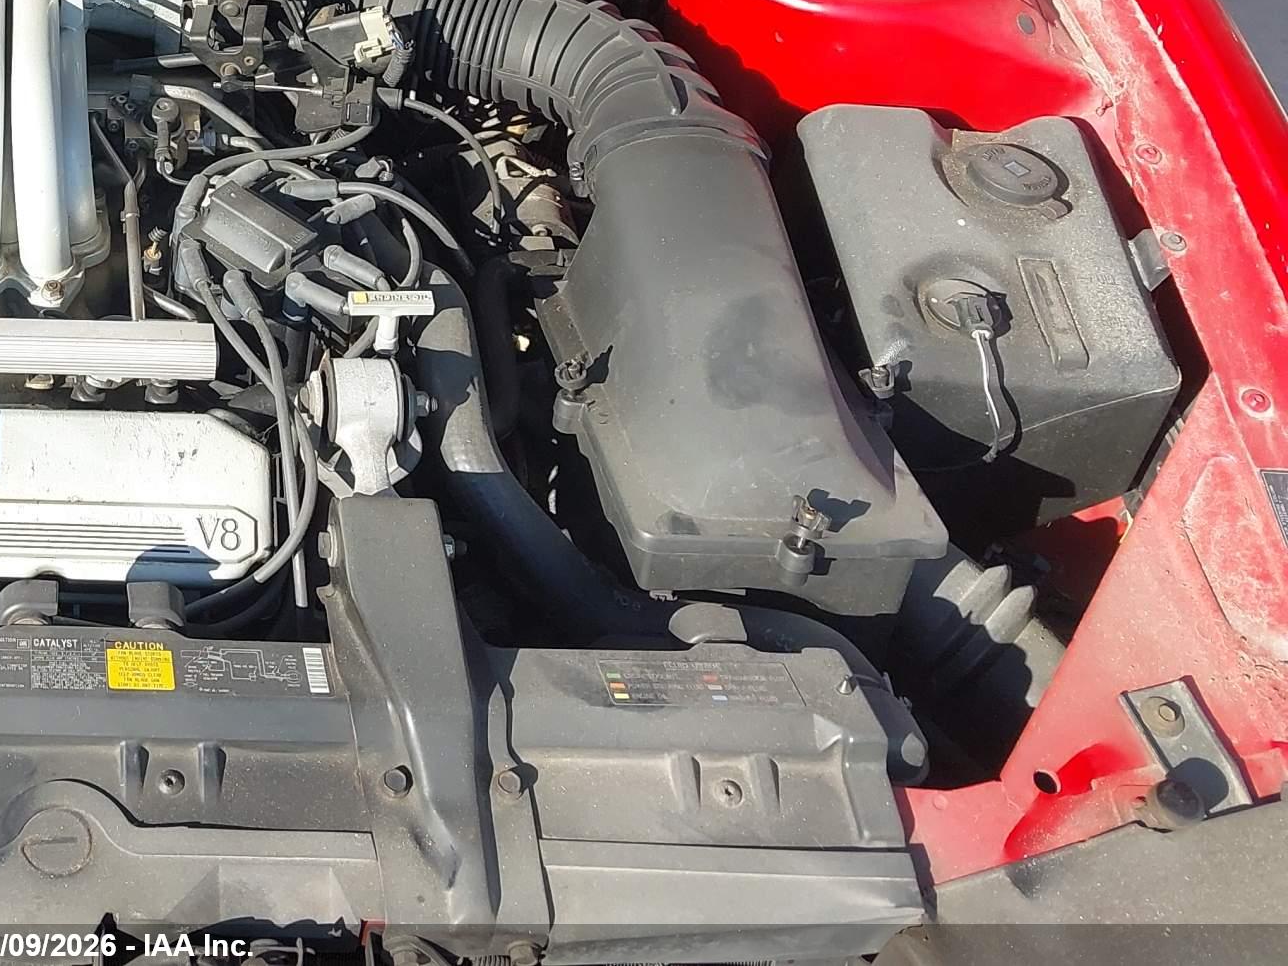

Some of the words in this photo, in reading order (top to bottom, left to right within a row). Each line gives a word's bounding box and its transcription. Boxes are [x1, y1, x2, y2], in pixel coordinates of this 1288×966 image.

[196, 518, 241, 551] V8
[33, 638, 78, 648] CATALYST
[114, 641, 164, 651] CAUTION
